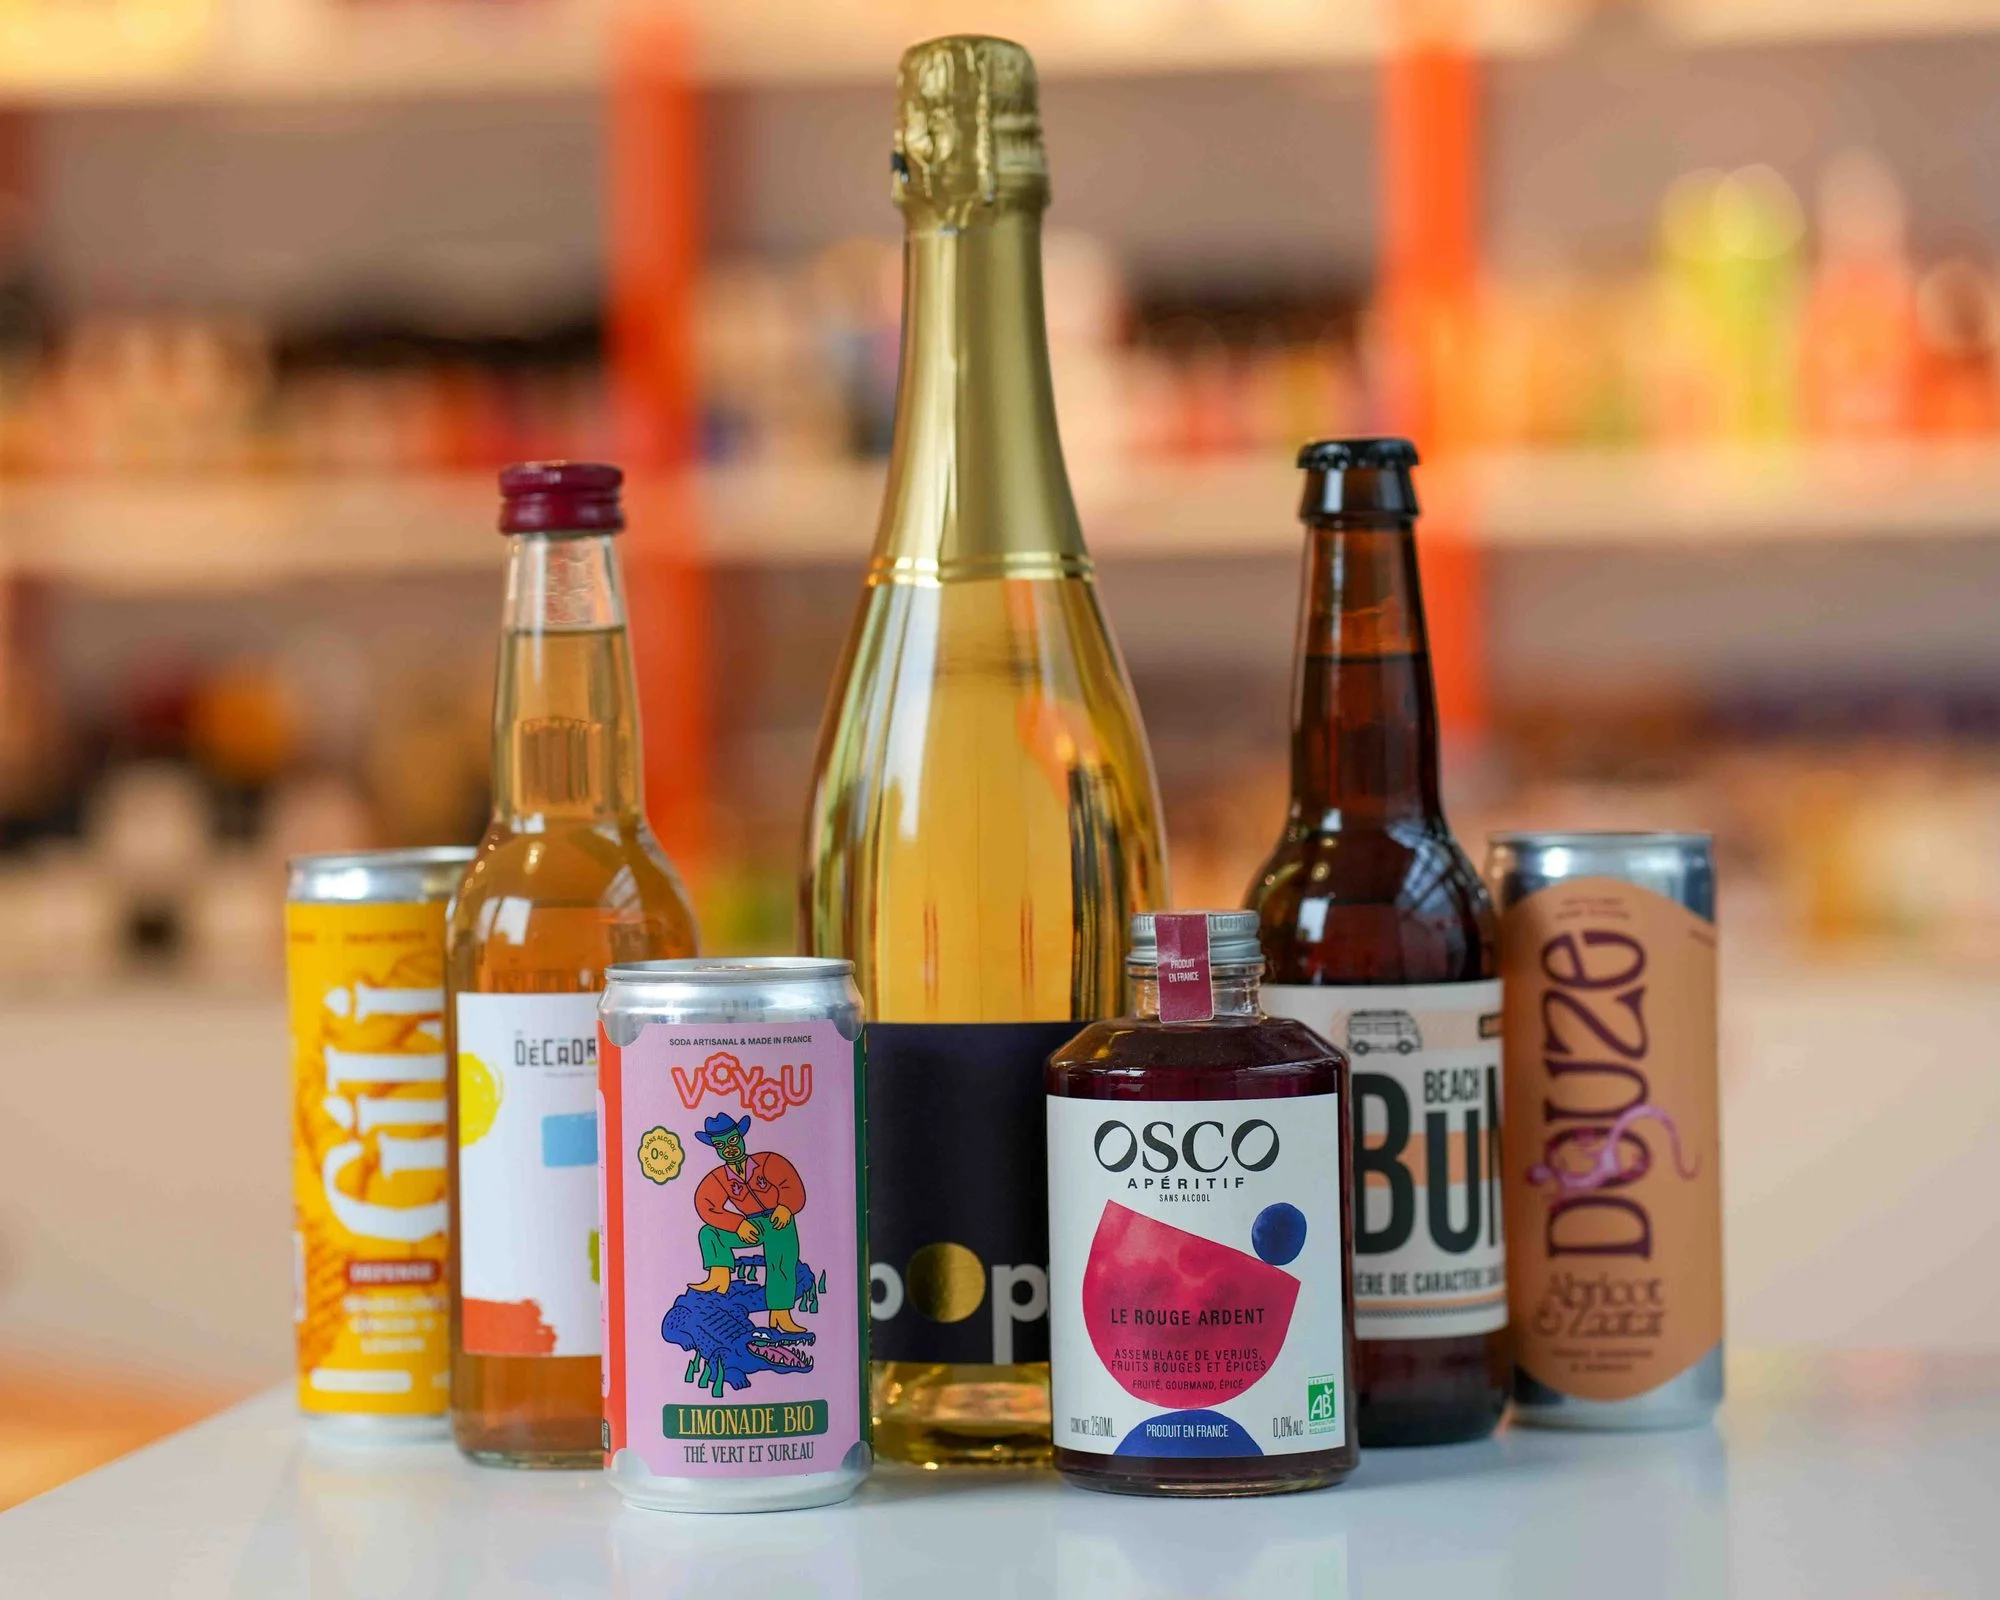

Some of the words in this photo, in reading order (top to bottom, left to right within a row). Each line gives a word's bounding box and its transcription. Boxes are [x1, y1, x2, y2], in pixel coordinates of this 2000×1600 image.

[1170, 959, 1195, 969] PRODUIT
[1168, 973, 1177, 983] EN
[1177, 971, 1199, 982] FRANCE
[669, 1038, 691, 1046] SODA
[692, 1038, 738, 1046] ARTISANAL
[741, 1037, 746, 1045] &
[748, 1036, 772, 1045] MADE
[773, 1036, 781, 1044] IN
[783, 1035, 812, 1044] FRANCE
[670, 1051, 813, 1122] VOYOU
[1424, 1068, 1479, 1103] BEACH
[644, 1135, 657, 1150] SANS
[657, 1135, 677, 1152] ALCOOL
[1094, 1119, 1280, 1173] OSCO
[651, 1148, 668, 1160] 0%
[644, 1156, 665, 1175] ALCOHOL
[665, 1160, 677, 1173] FREE
[1127, 1175, 1244, 1190] APÉRITIF
[1159, 1193, 1179, 1202] SANS
[1182, 1193, 1211, 1202] ALCOOL
[1389, 1271, 1408, 1296] DE
[1111, 1308, 1127, 1324] LE
[1134, 1308, 1191, 1326] ROUGE
[1198, 1307, 1265, 1326] ARDENT
[1114, 1348, 1189, 1361] ASSEMBLAGE
[1194, 1349, 1210, 1361] DE
[1215, 1348, 1263, 1361] VERJUS,
[1111, 1360, 1149, 1373] FRUITS
[1154, 1361, 1201, 1373] ROUGES
[1207, 1361, 1221, 1373] ET
[1226, 1359, 1267, 1373] ÉPICES
[1132, 1378, 1163, 1390] FRUITÉ,
[1165, 1379, 1217, 1390] GOURMAND,
[1219, 1377, 1244, 1390] ÉPICÉ
[1310, 1393, 1333, 1420] AB
[678, 1407, 778, 1436] LIMONADE
[783, 1404, 814, 1433] BIO
[1273, 1415, 1292, 1440] 0,0%
[1146, 1424, 1181, 1438] PRODUIT
[1183, 1424, 1194, 1438] EN
[1196, 1424, 1229, 1438] FRANCE
[683, 1443, 708, 1464] THÉ
[711, 1445, 745, 1464] VERT
[748, 1444, 764, 1463] ET
[767, 1441, 814, 1462] SUREAU
